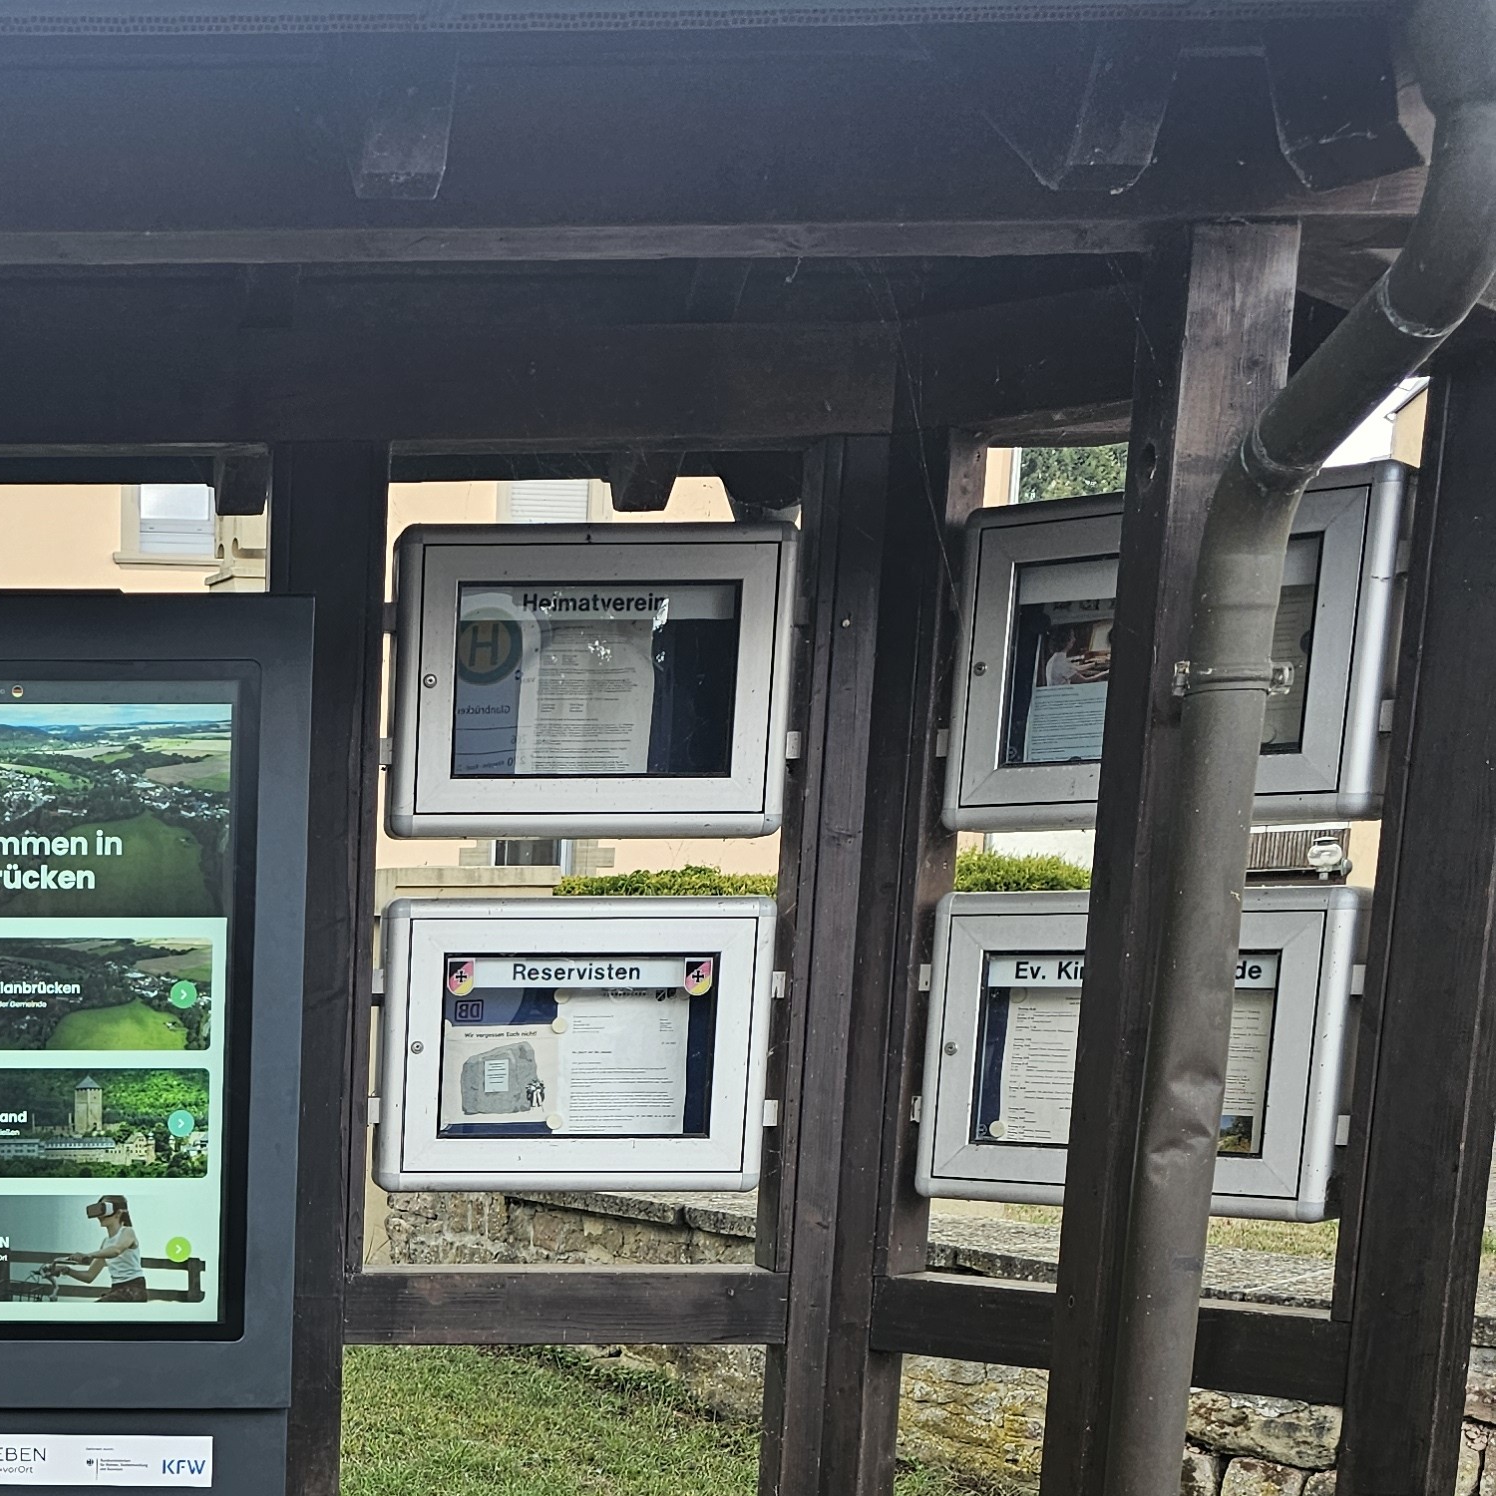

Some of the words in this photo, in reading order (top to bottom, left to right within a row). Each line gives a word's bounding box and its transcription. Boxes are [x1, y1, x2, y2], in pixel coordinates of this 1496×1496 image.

[523, 593, 666, 612] Heimatverein
[95, 830, 123, 857] in
[513, 963, 641, 981] Reservisten
[1015, 961, 1046, 980] Ev.
[1235, 961, 1263, 980] de
[9, 1000, 47, 1008] Gemeinde
